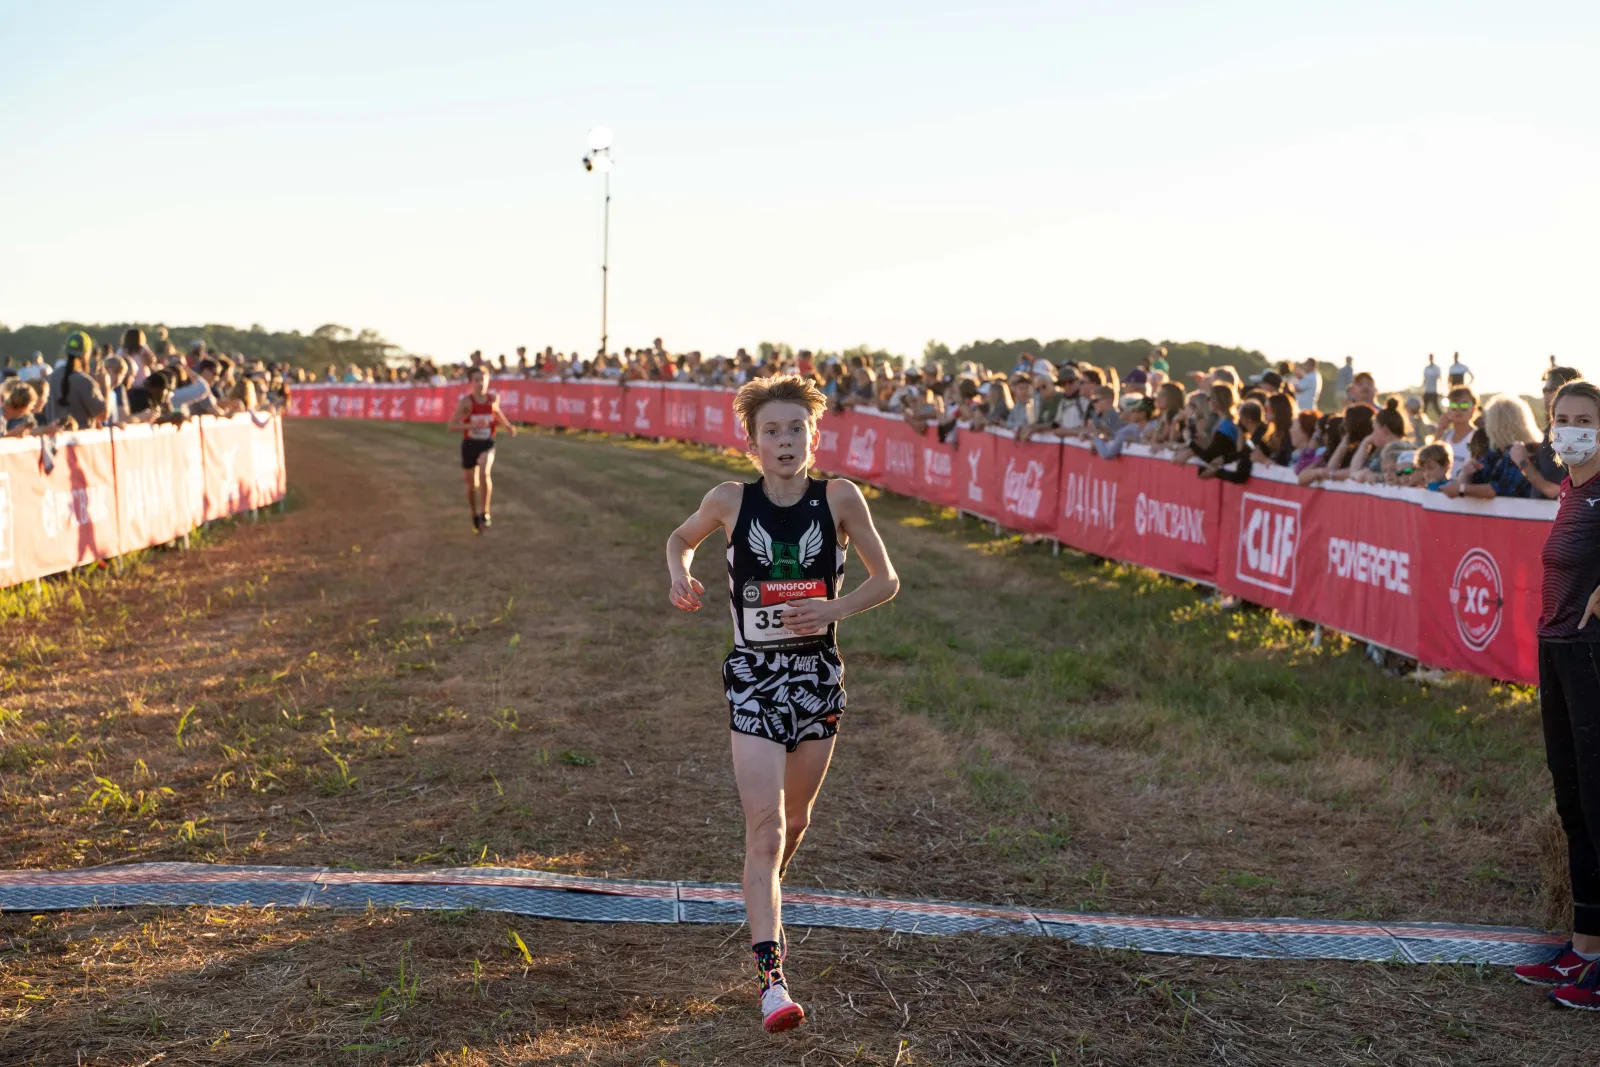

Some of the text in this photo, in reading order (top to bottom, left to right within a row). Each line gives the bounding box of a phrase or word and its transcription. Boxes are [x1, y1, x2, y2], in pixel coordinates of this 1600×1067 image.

[1245, 507, 1296, 578] CLIF
[1328, 536, 1412, 596] POWERADE
[766, 581, 818, 592] WINGFOOT
[1464, 585, 1490, 615] XC
[793, 655, 819, 673] NIKE
[790, 685, 827, 715] NIKE
